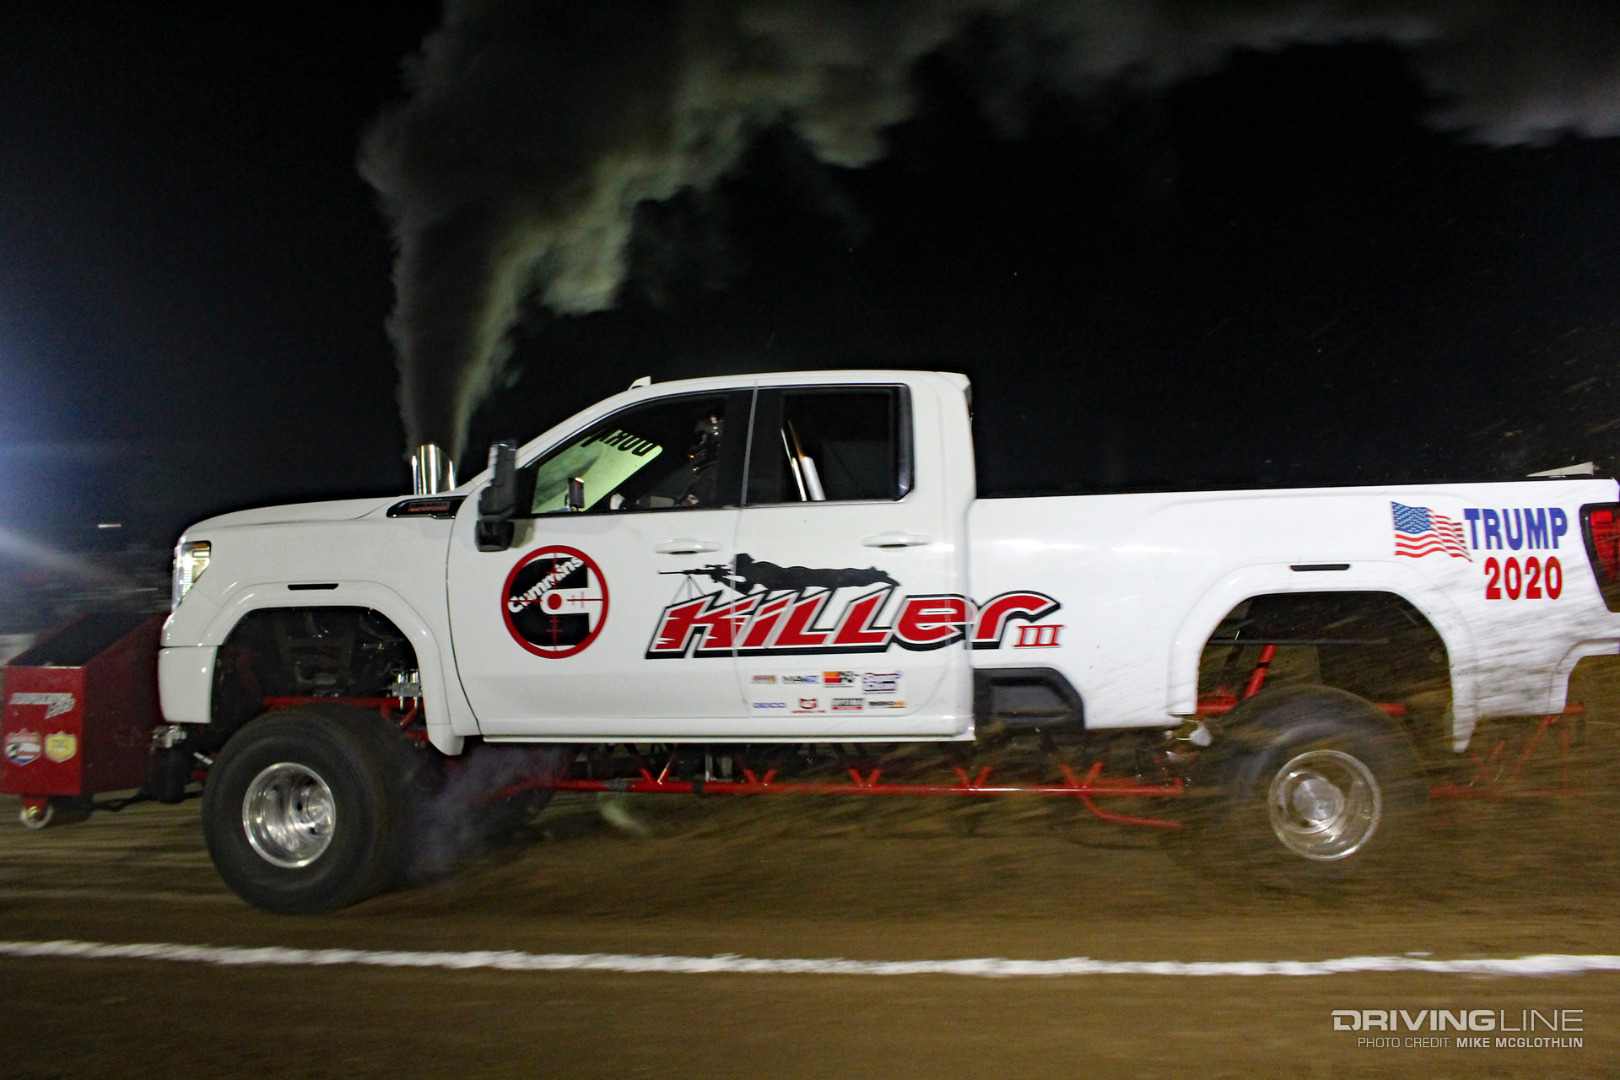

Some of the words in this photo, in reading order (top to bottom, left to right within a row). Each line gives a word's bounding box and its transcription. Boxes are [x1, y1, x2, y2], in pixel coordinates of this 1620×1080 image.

[1463, 507, 1568, 550] TRUMP
[507, 556, 584, 613] Cummins
[1484, 556, 1563, 600] 2020
